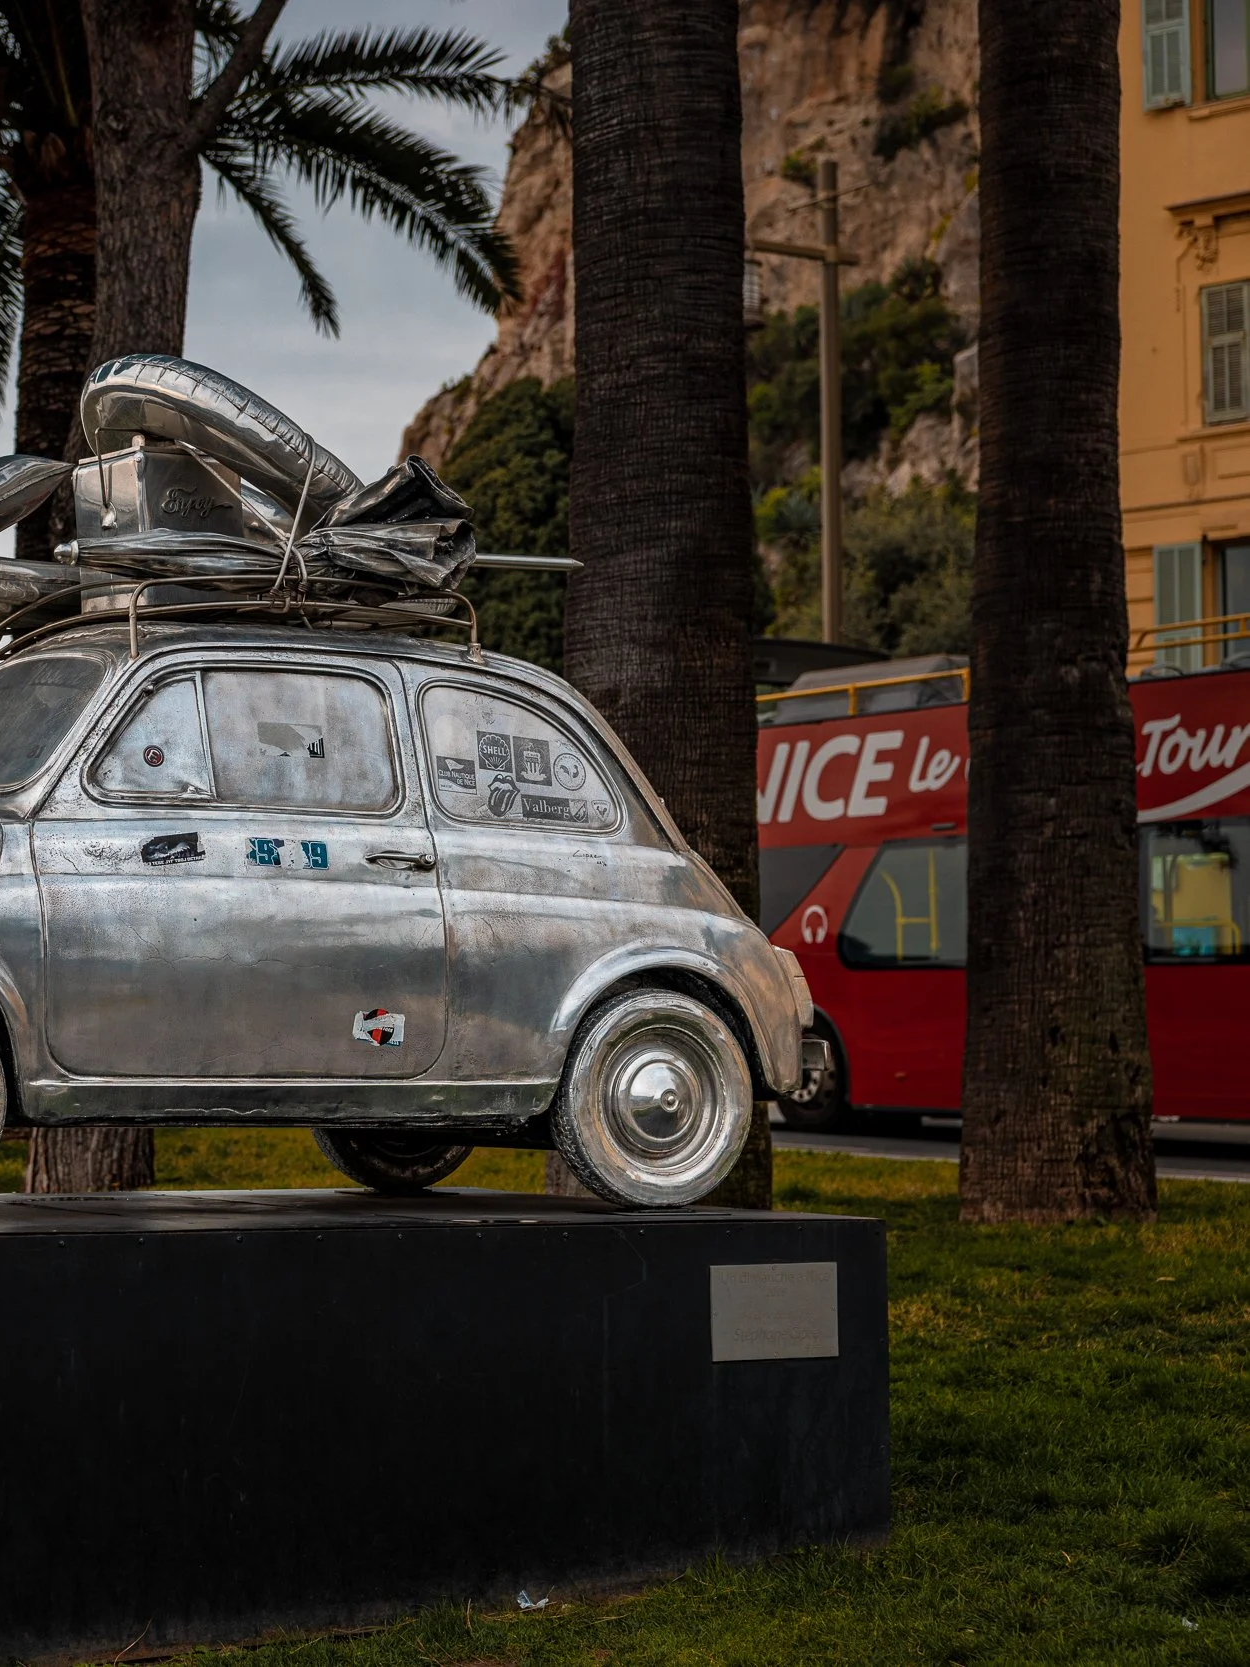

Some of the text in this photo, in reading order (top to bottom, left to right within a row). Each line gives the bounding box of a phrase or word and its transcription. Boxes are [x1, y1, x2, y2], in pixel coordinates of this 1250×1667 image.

[482, 745, 507, 756] SHELL
[908, 735, 961, 793] le
[1140, 713, 1250, 777] Tour
[522, 797, 570, 819] Valberg
